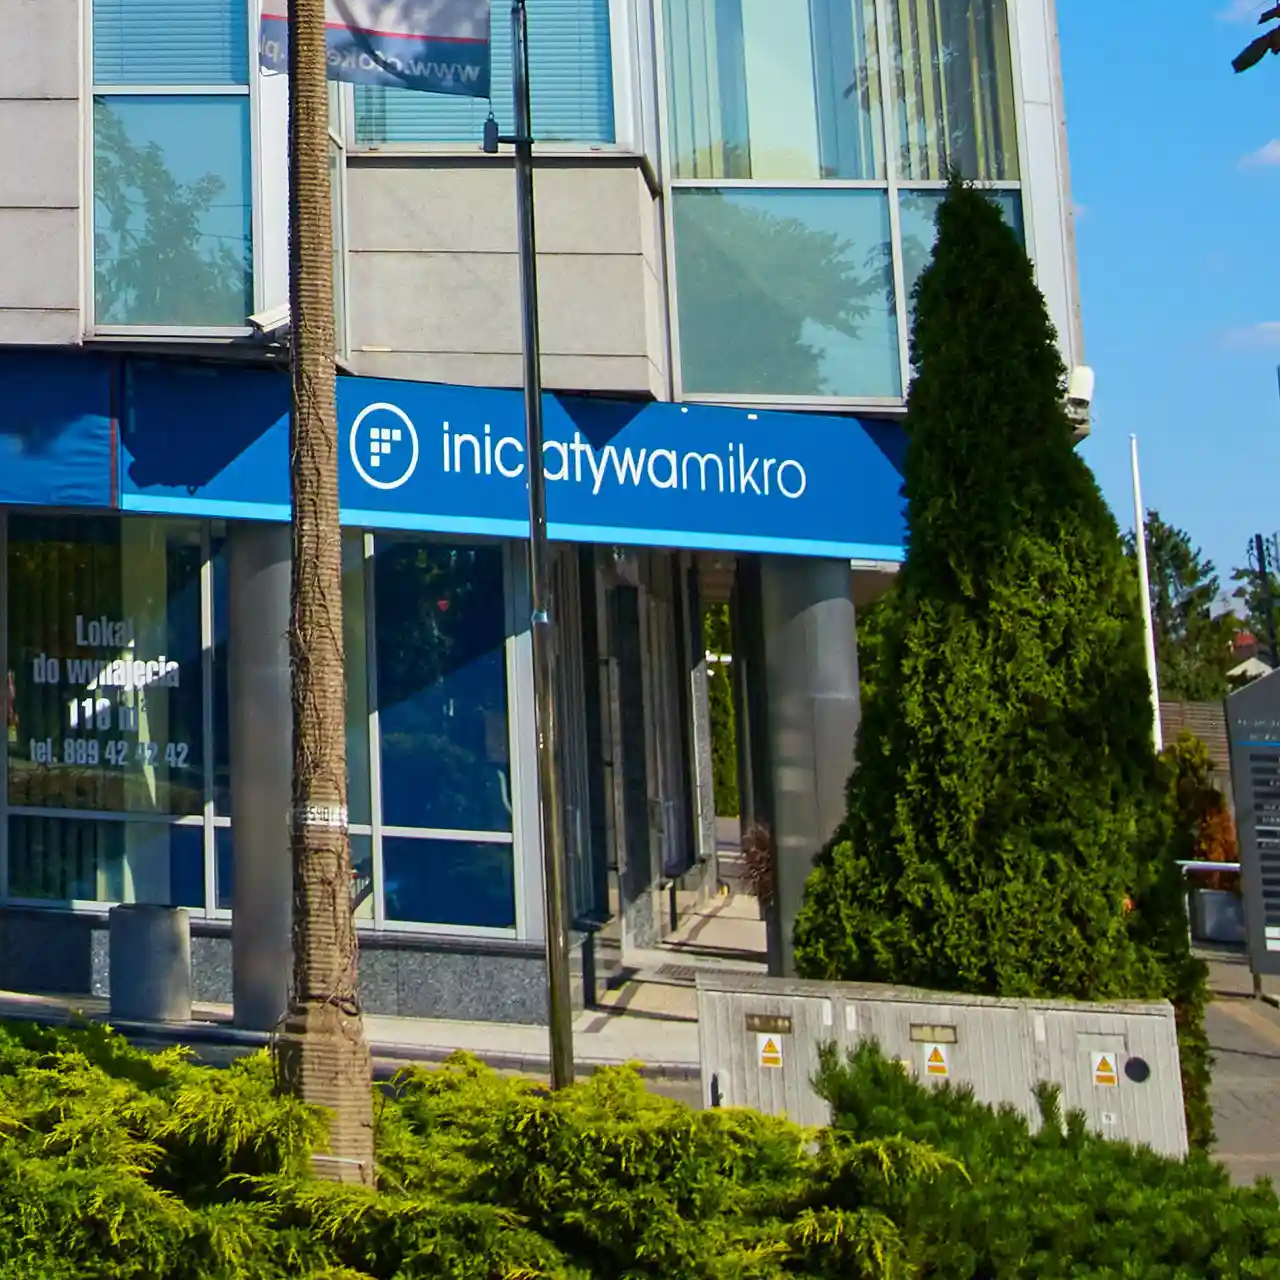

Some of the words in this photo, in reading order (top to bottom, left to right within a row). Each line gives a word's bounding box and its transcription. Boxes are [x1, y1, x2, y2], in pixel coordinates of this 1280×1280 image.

[441, 421, 807, 499] inicatywamikro
[75, 614, 135, 648] Lokal
[32, 653, 59, 684] do
[66, 655, 180, 690] wynajęcia
[30, 738, 58, 764] tel.
[105, 740, 129, 766] 42
[165, 742, 190, 768] 42
